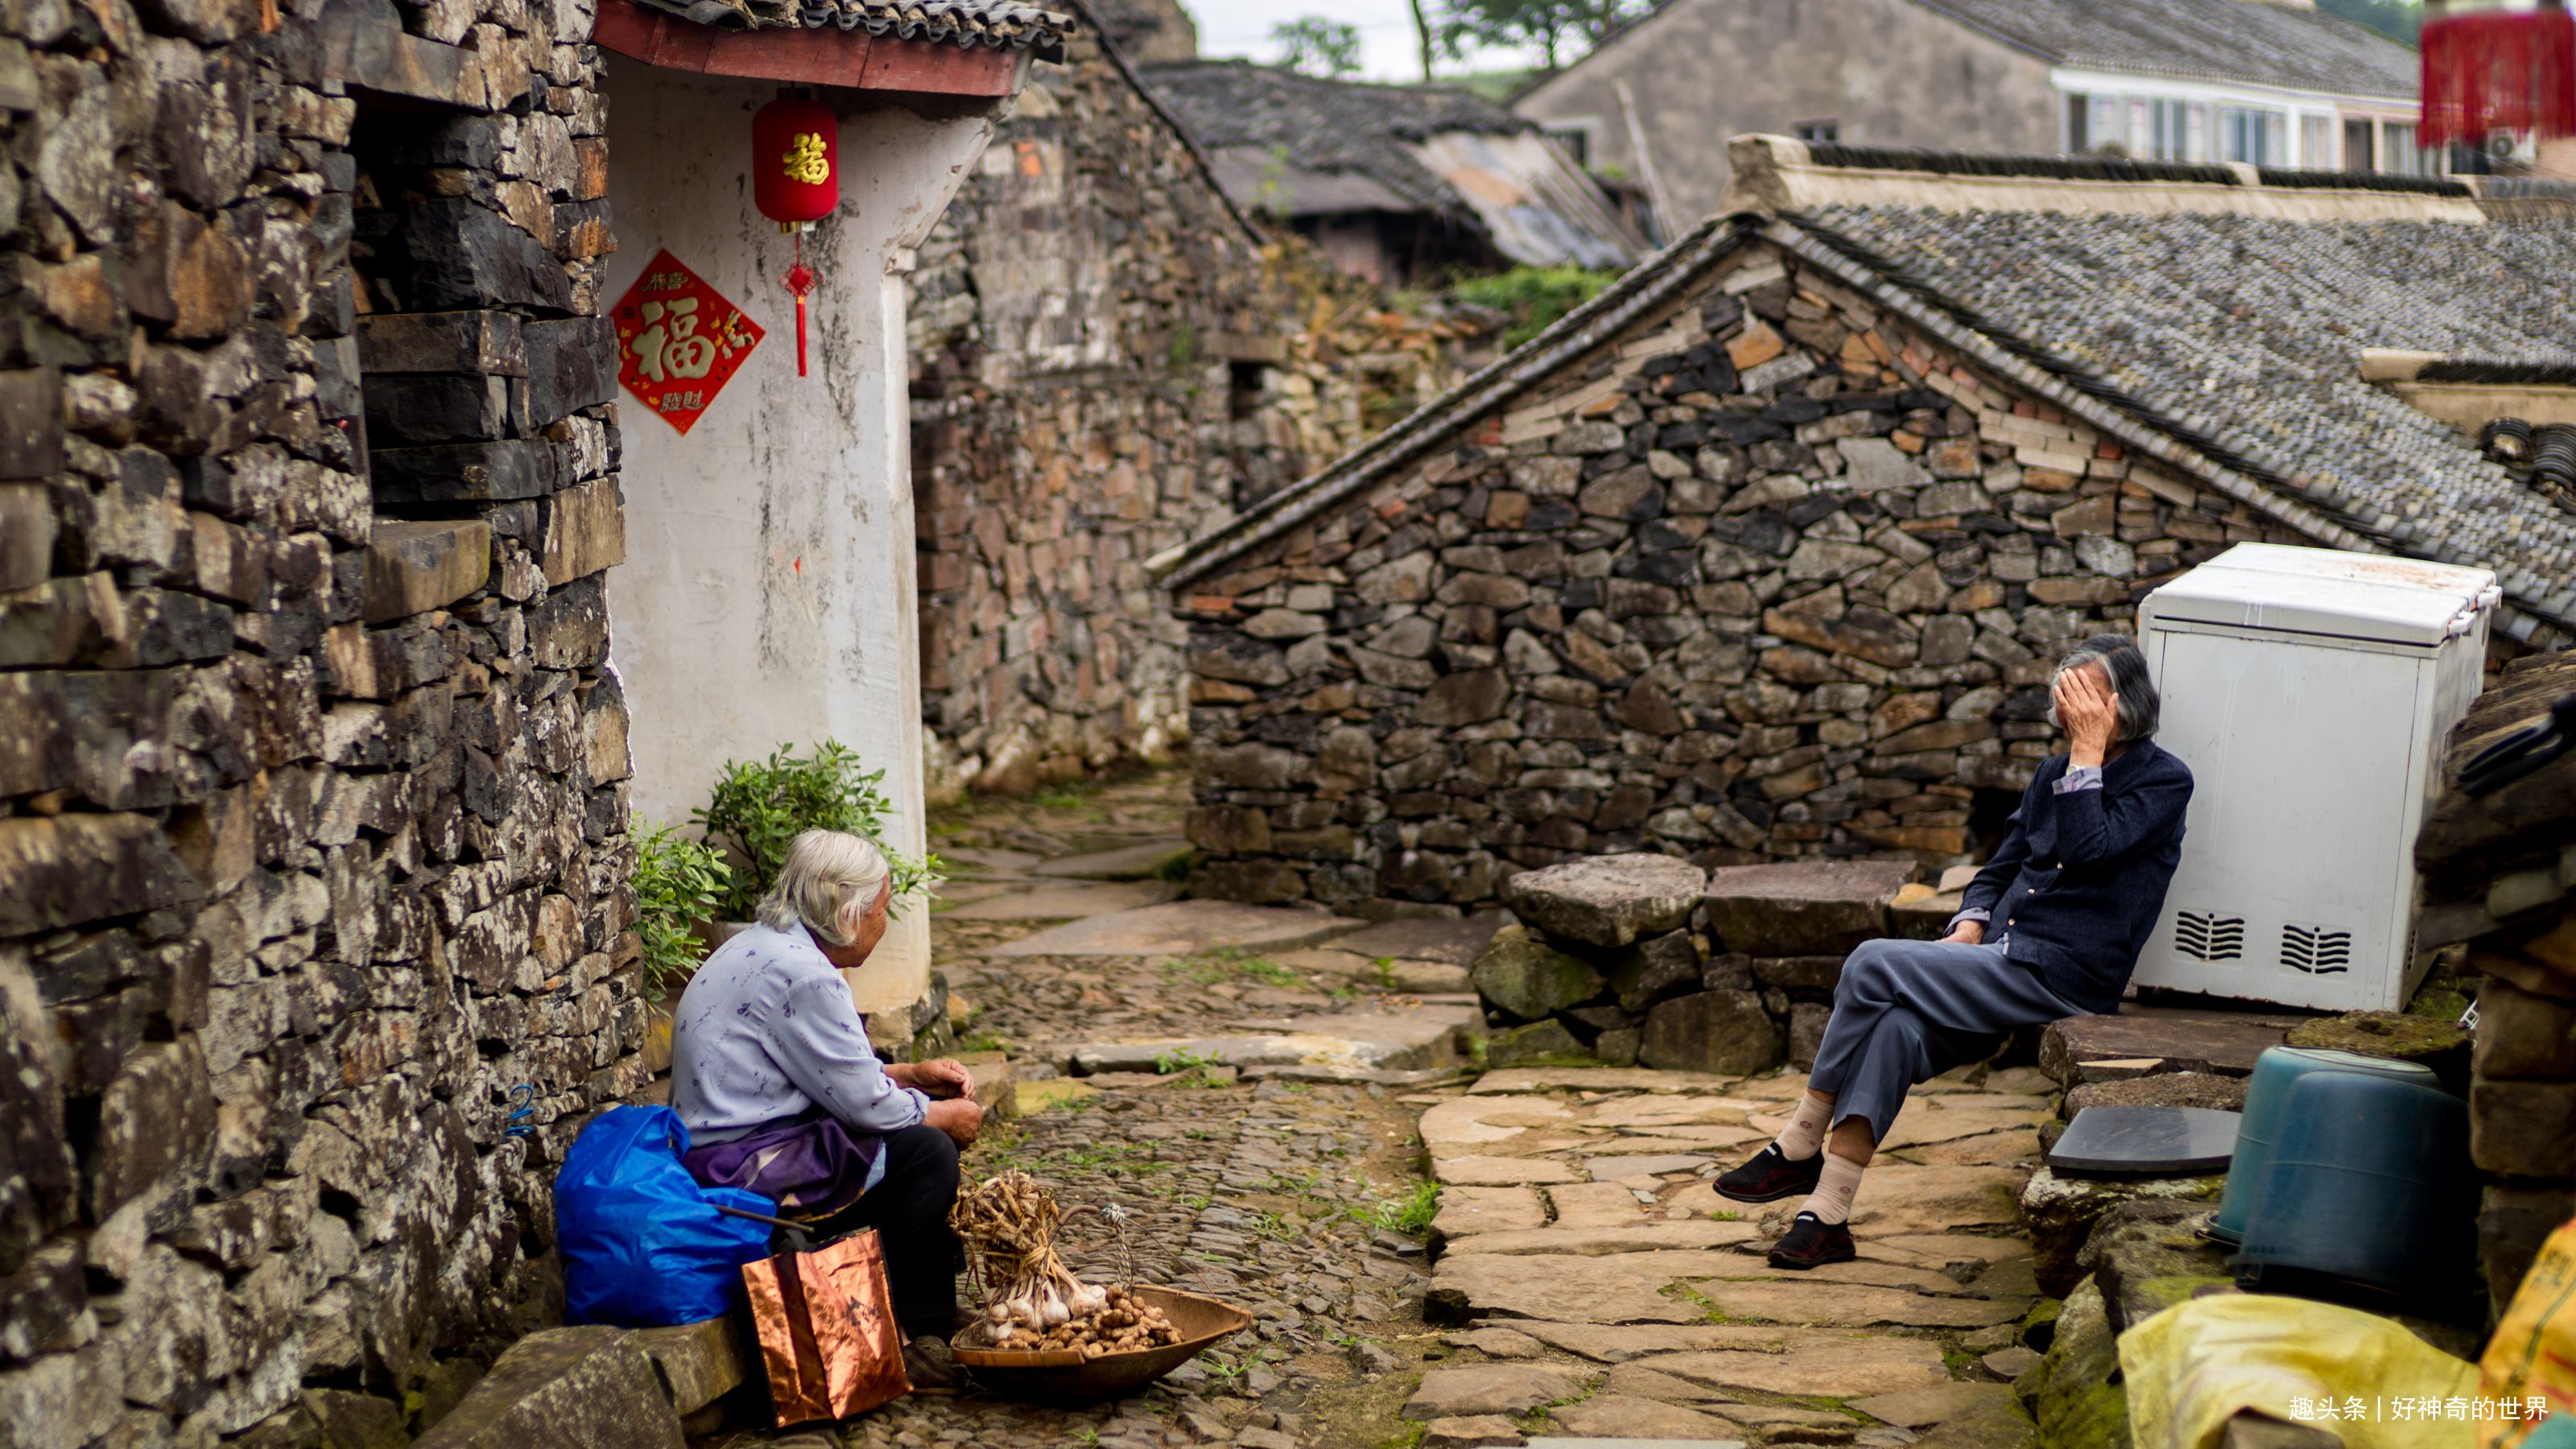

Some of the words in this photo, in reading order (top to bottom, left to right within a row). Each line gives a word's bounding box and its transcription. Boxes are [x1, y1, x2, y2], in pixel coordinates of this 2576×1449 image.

[782, 132, 829, 185] 福
[641, 271, 688, 291] 恭喜
[630, 296, 716, 383] 福
[658, 389, 705, 414] 發財
